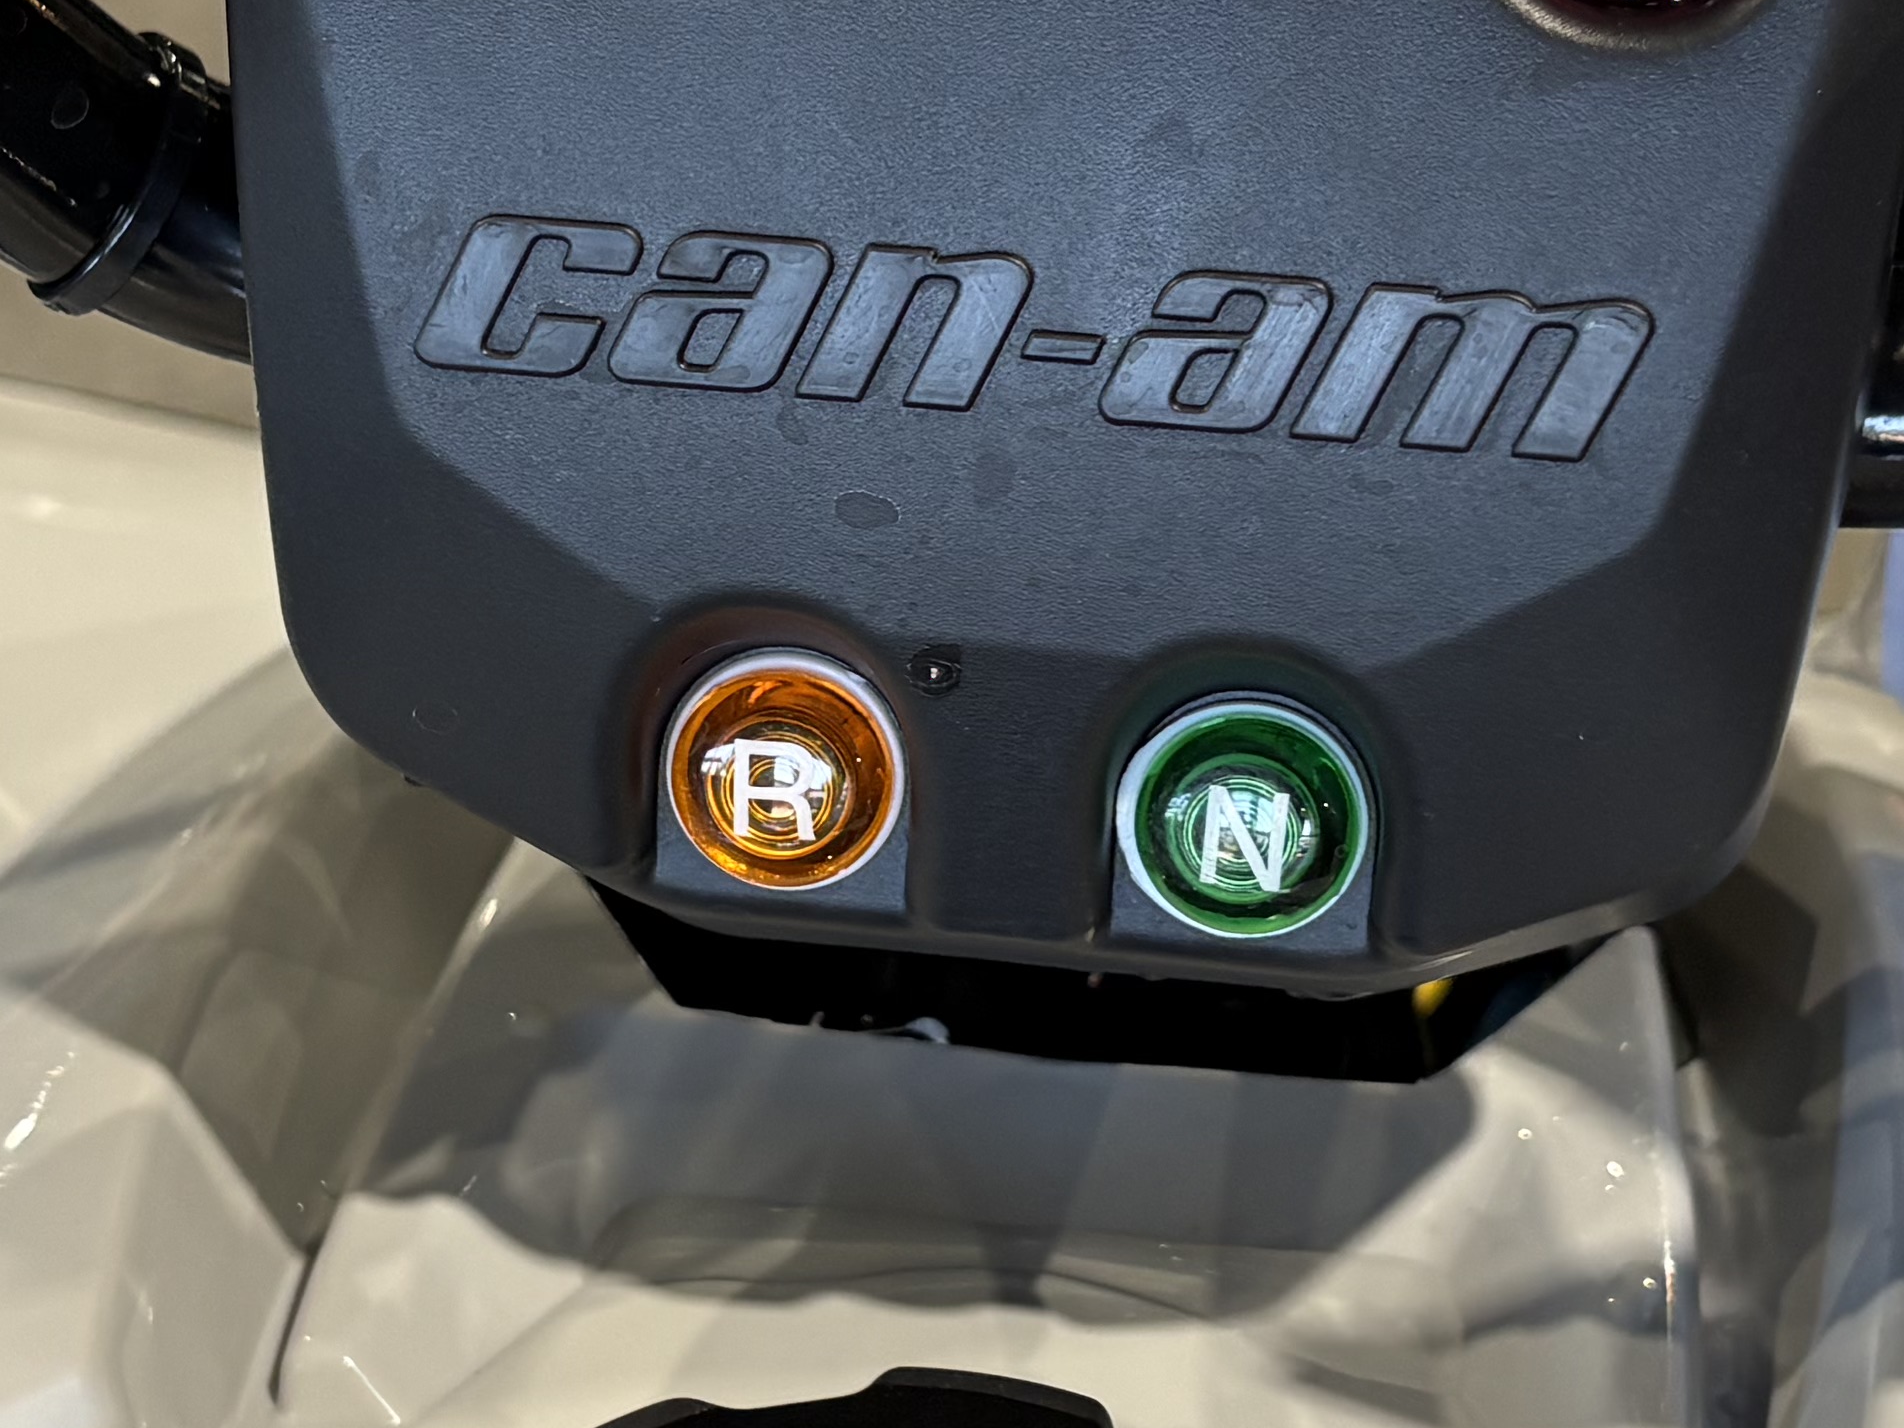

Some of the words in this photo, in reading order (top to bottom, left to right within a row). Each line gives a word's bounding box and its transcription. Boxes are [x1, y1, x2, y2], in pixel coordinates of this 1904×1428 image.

[412, 211, 1656, 464] can-am
[728, 737, 818, 844] R
[1198, 784, 1292, 895] N
